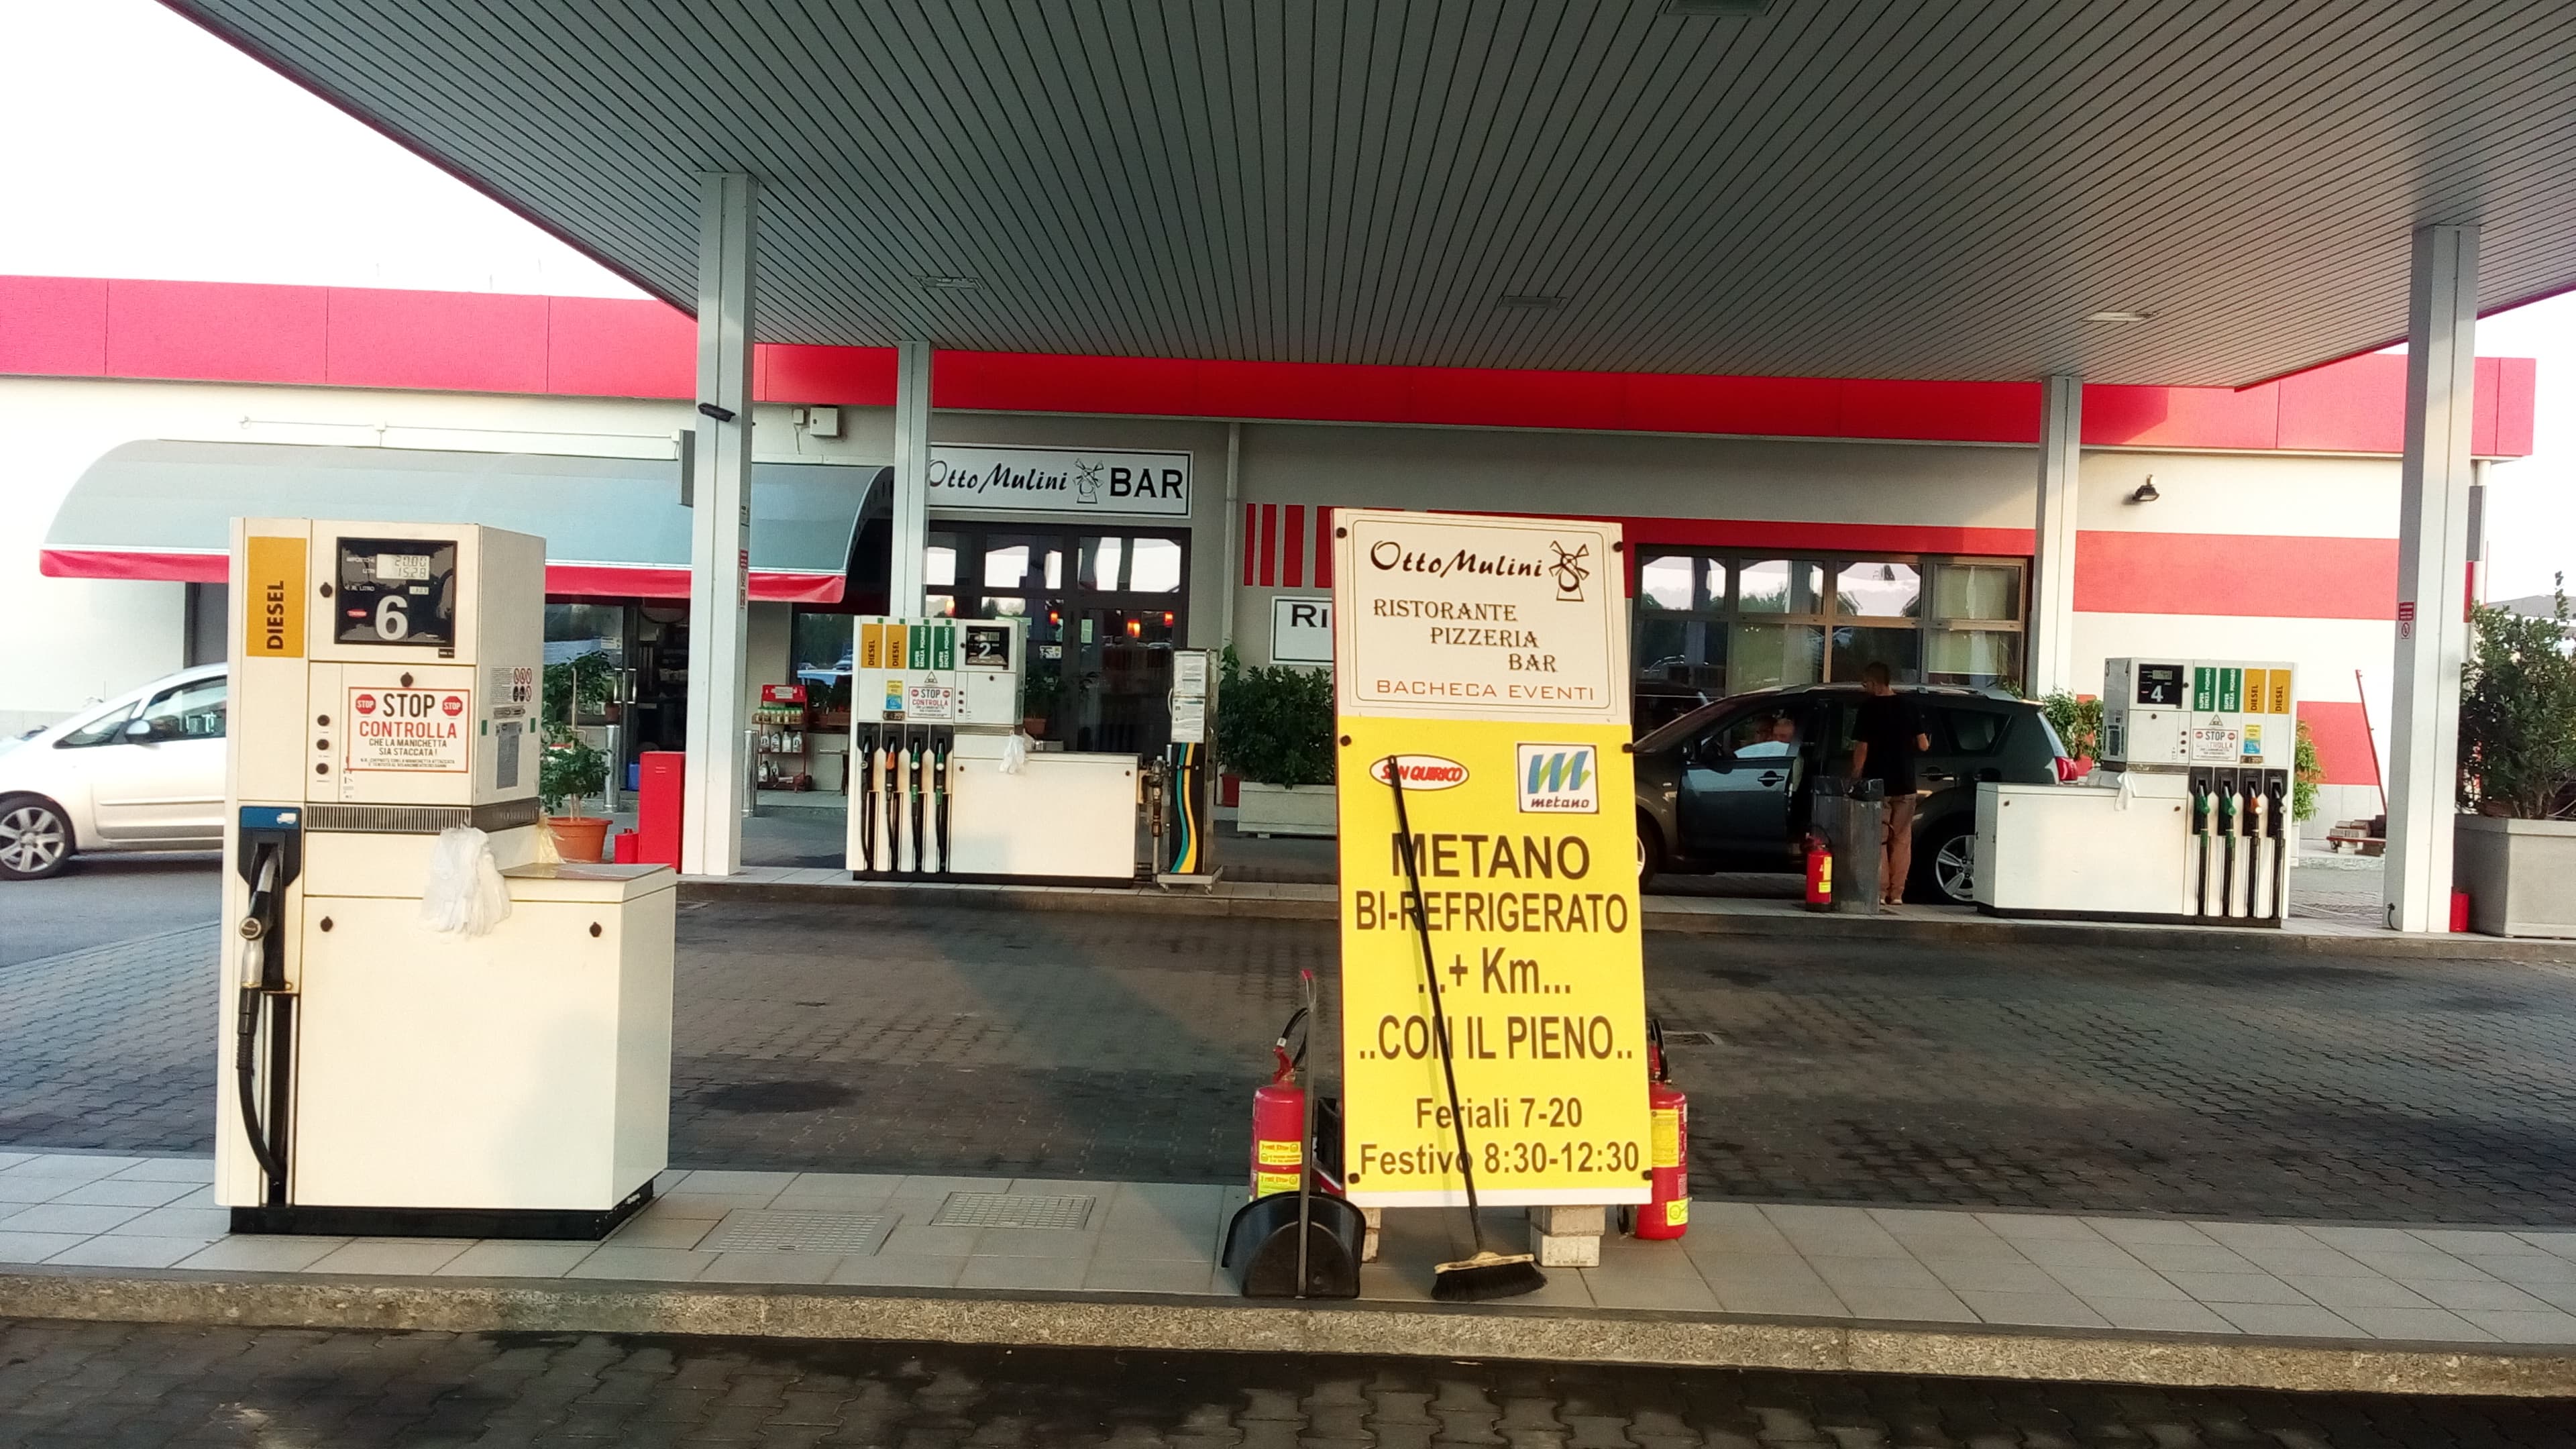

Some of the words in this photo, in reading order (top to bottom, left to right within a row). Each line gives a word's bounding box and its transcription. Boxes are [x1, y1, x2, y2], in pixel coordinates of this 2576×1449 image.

[930, 460, 978, 490] Otto
[977, 462, 1068, 494] Mulini
[1110, 467, 1184, 500] BAR
[1371, 540, 1442, 572] Otto
[1440, 549, 1543, 578] Mulini
[266, 580, 284, 650] DIESEL
[376, 595, 409, 641] 6
[1373, 598, 1519, 622] RISTORANTE
[1430, 627, 1540, 649] PIZZERIA
[979, 642, 991, 659] 2
[1508, 653, 1558, 673] BAR
[920, 688, 941, 698] STOP
[1377, 679, 1497, 698] BACHECA
[1509, 684, 1594, 700] EVENTI
[2150, 685, 2164, 702] 4
[2250, 684, 2259, 711] DIESEL
[2275, 686, 2283, 711] DIESEL
[357, 700, 374, 708] STOP
[383, 693, 435, 718] STOP
[443, 702, 461, 710] STOP
[360, 720, 457, 739] CONTROLLA
[2204, 731, 2225, 741] STOP
[369, 739, 384, 747] CHE
[385, 739, 395, 747] LA
[396, 739, 447, 748] MANICHETTA
[379, 747, 392, 755] SIA
[394, 748, 433, 756] STACCATA
[1381, 764, 1411, 781] SN
[1531, 796, 1590, 808] metano
[1391, 833, 1590, 879] METANO
[1355, 890, 1628, 934] BI-REFRIGERATO
[1467, 1016, 1497, 1059] IL
[1520, 1096, 1583, 1128] 7-20
[1360, 1142, 1473, 1175] Festivo
[1484, 1140, 1640, 1174] 8:30-12:30
